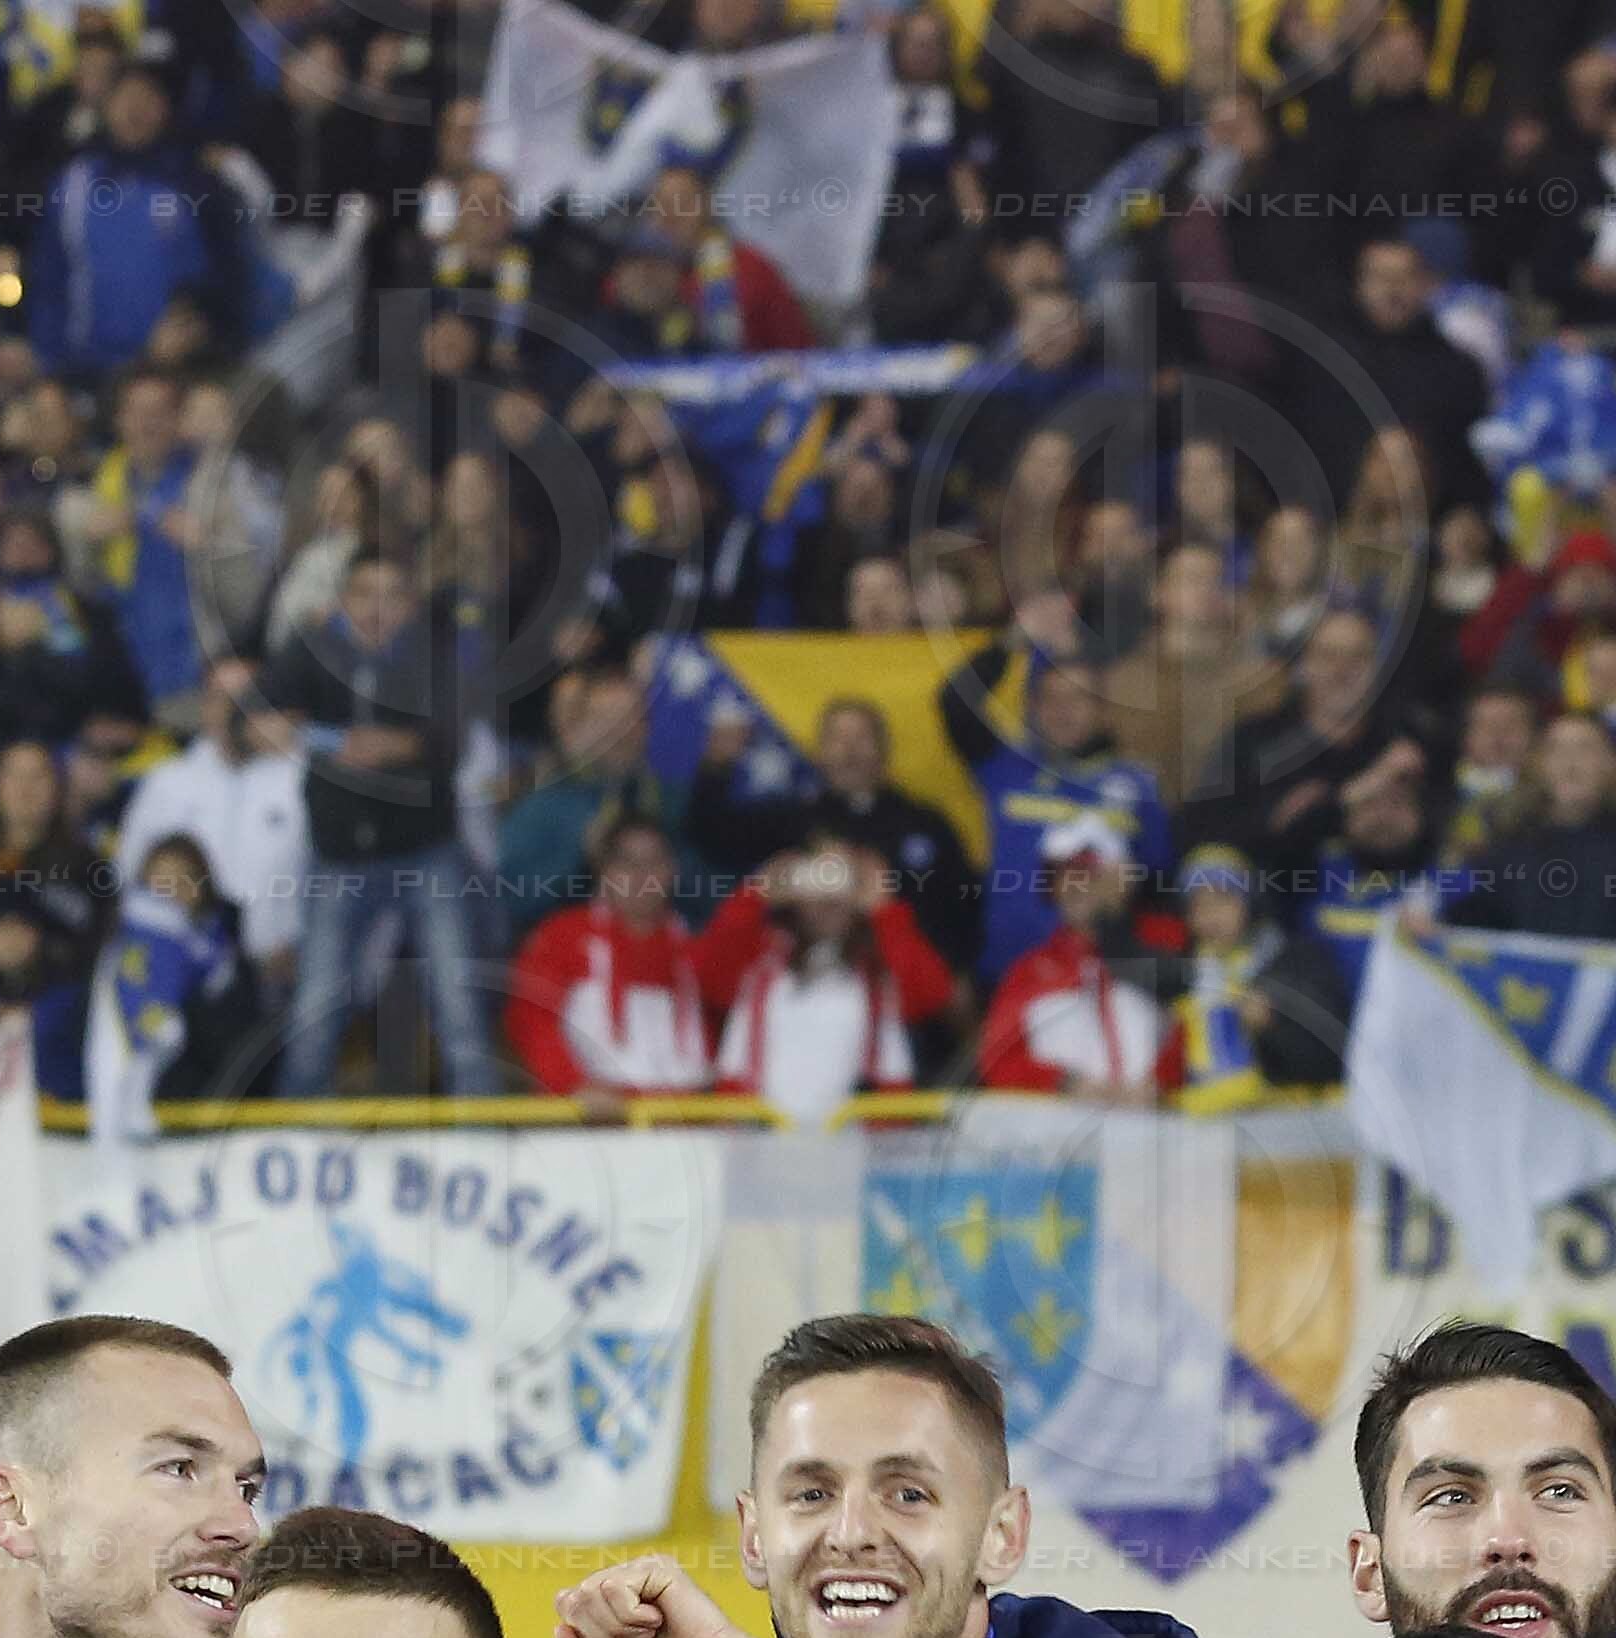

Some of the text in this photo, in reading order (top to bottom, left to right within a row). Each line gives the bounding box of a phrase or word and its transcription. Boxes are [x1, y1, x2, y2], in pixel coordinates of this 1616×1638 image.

[254, 1143, 358, 1206] OD
[395, 1152, 643, 1312] BOSNE
[260, 1425, 560, 1516] DACAC
